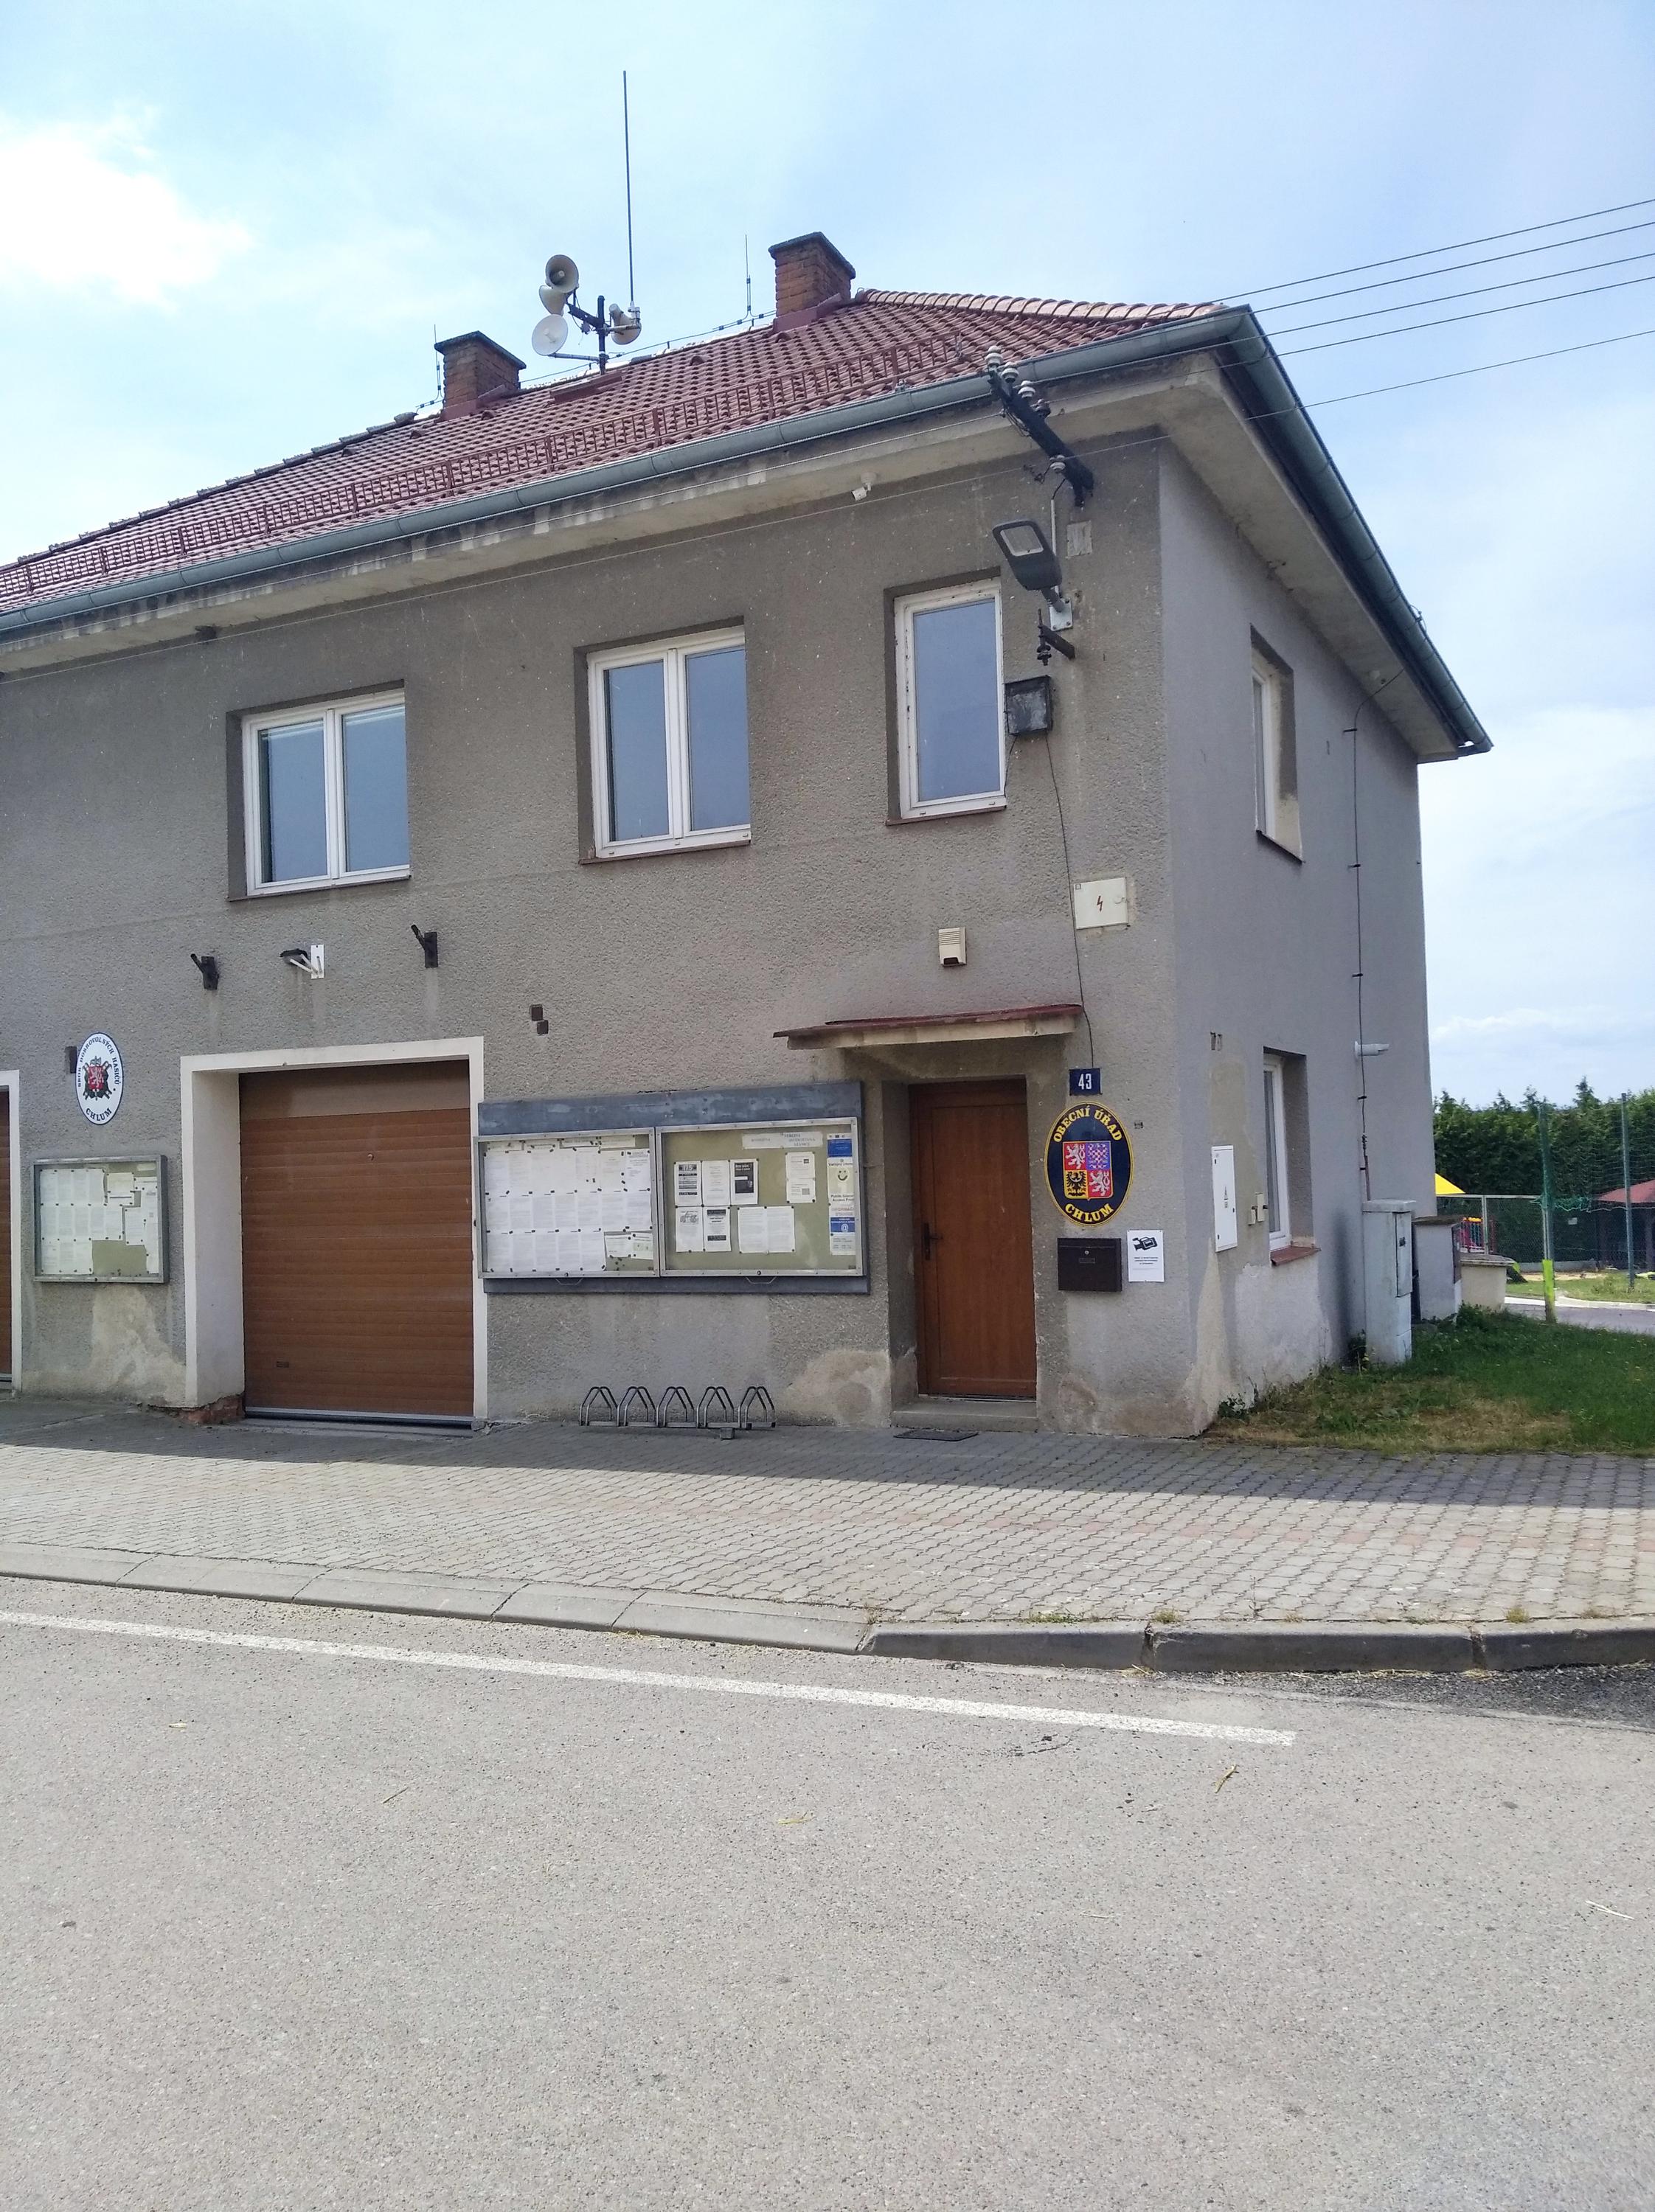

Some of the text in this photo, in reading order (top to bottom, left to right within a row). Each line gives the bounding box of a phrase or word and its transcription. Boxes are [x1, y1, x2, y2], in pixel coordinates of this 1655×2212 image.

[1078, 1073, 1092, 1090] 43
[86, 1107, 112, 1121] CHLUM
[1053, 1106, 1123, 1142] OBECNÍ ÚŘAD
[1064, 1203, 1114, 1222] CHLUM
